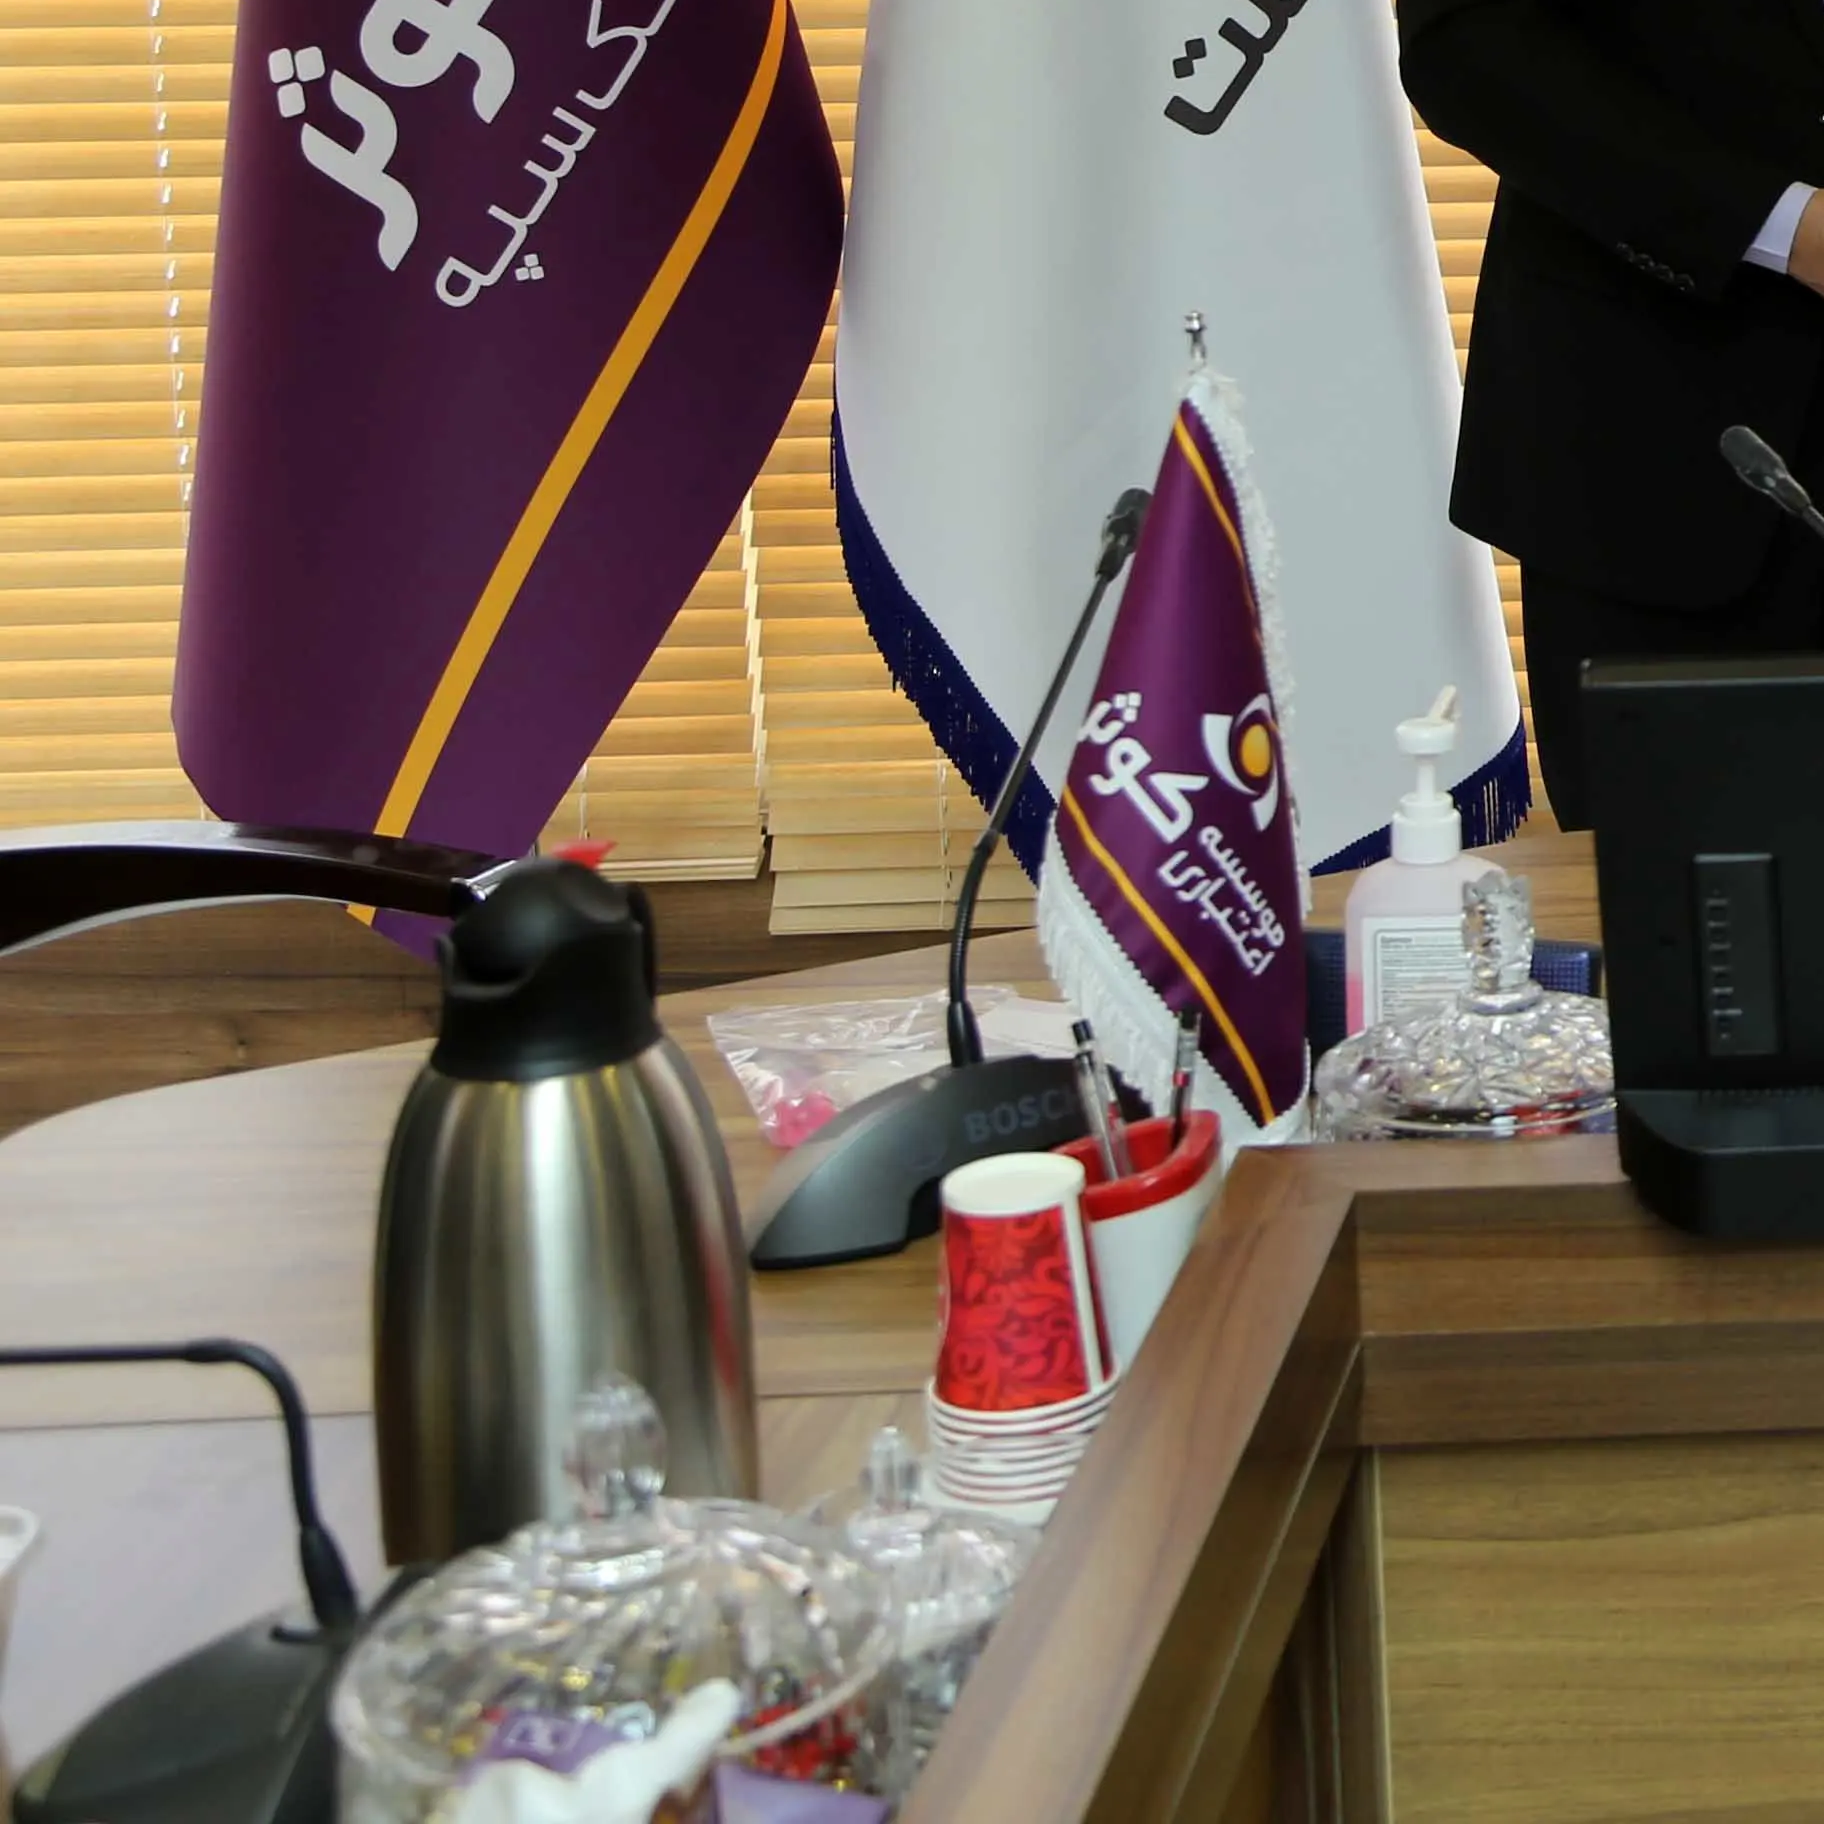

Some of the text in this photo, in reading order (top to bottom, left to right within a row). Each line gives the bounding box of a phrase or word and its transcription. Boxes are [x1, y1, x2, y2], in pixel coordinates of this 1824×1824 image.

[435, 106, 596, 308] سپه
[1157, 849, 1276, 976] اعتباری
[1197, 826, 1285, 947] موسسه
